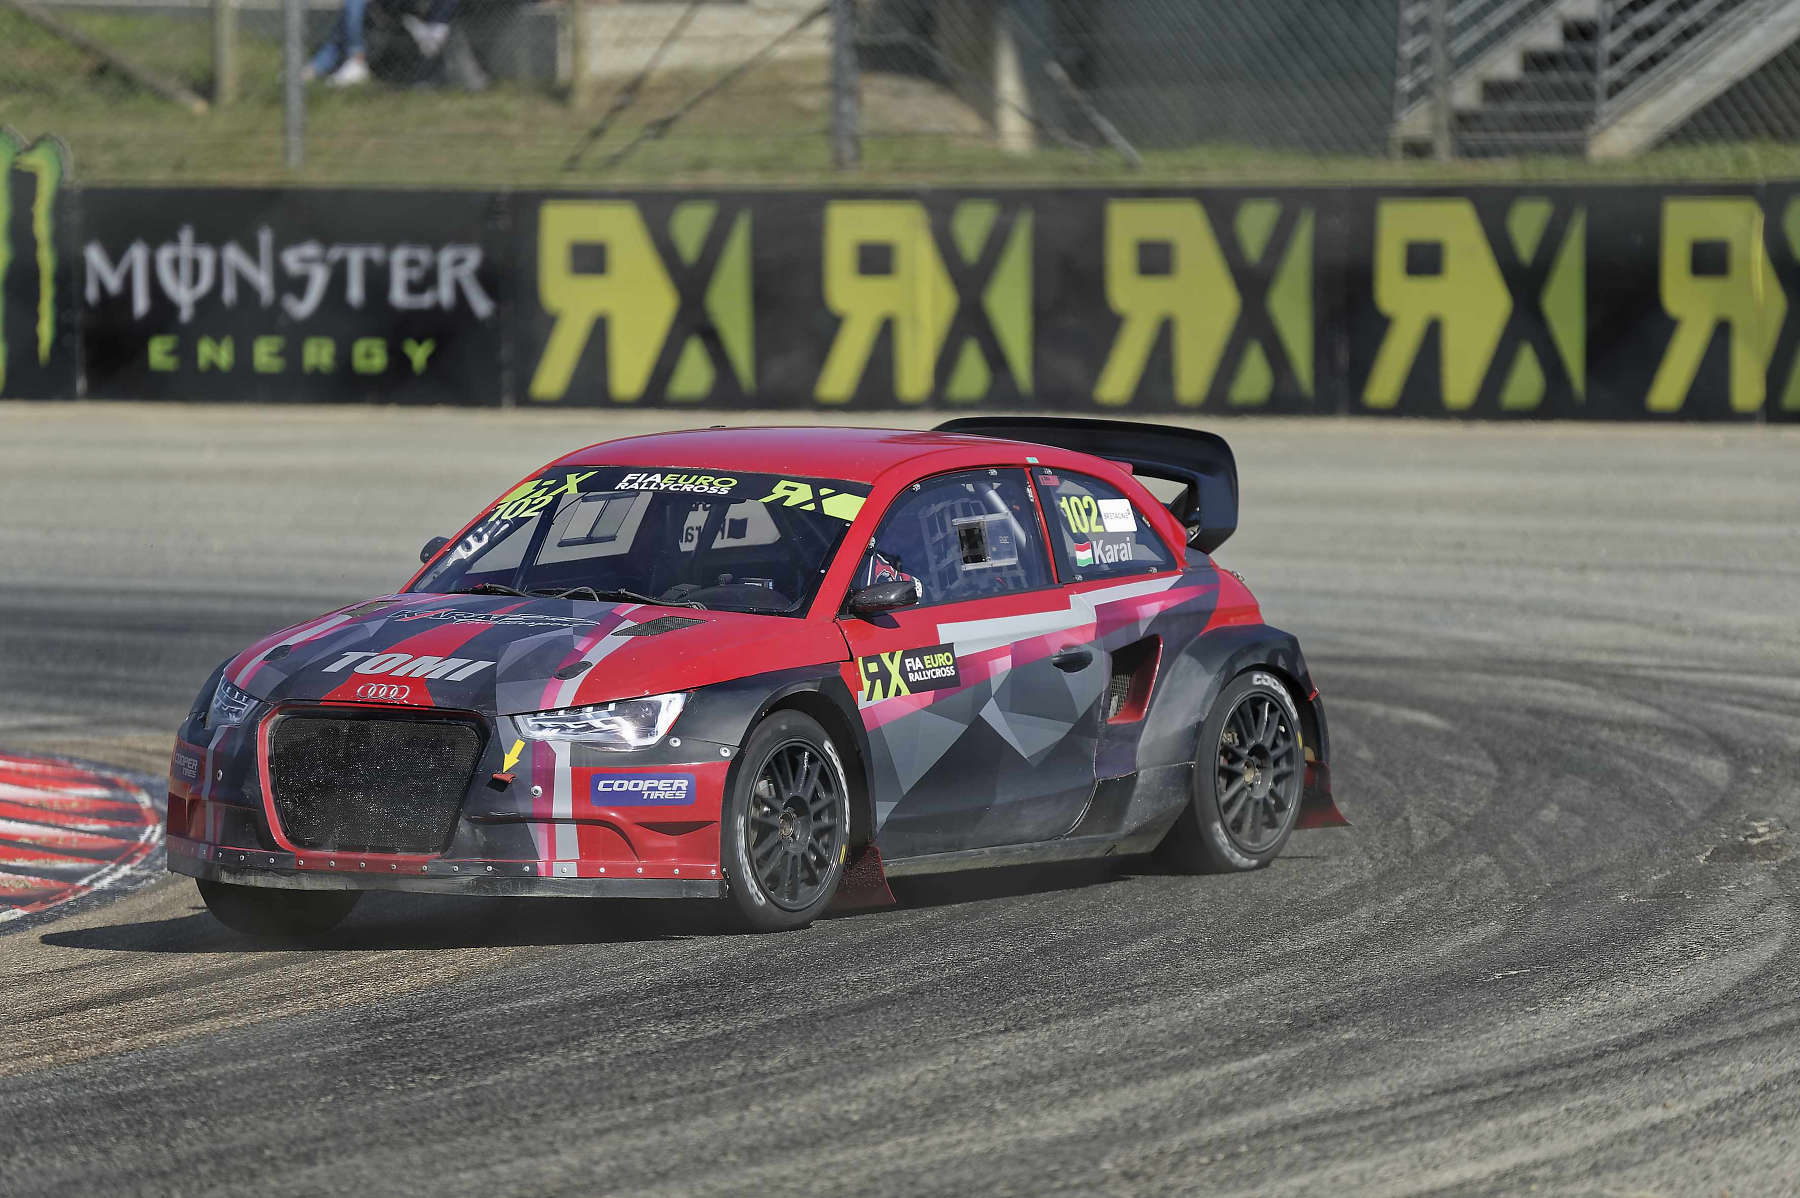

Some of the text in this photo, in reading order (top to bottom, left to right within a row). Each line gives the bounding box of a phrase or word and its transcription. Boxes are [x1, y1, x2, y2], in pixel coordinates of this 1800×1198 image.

[83, 223, 495, 324] MONSTER
[147, 334, 437, 375] ENERGY
[614, 482, 732, 495] RALLYCROSS
[487, 495, 554, 522] 102
[1059, 495, 1105, 533] 102
[1093, 536, 1133, 565] Karai
[321, 651, 497, 682] TOMI
[904, 652, 953, 672] FIA EURO
[908, 665, 956, 683] RALLYCROSS
[597, 779, 689, 792] COOPER
[641, 790, 687, 800] TIRES
